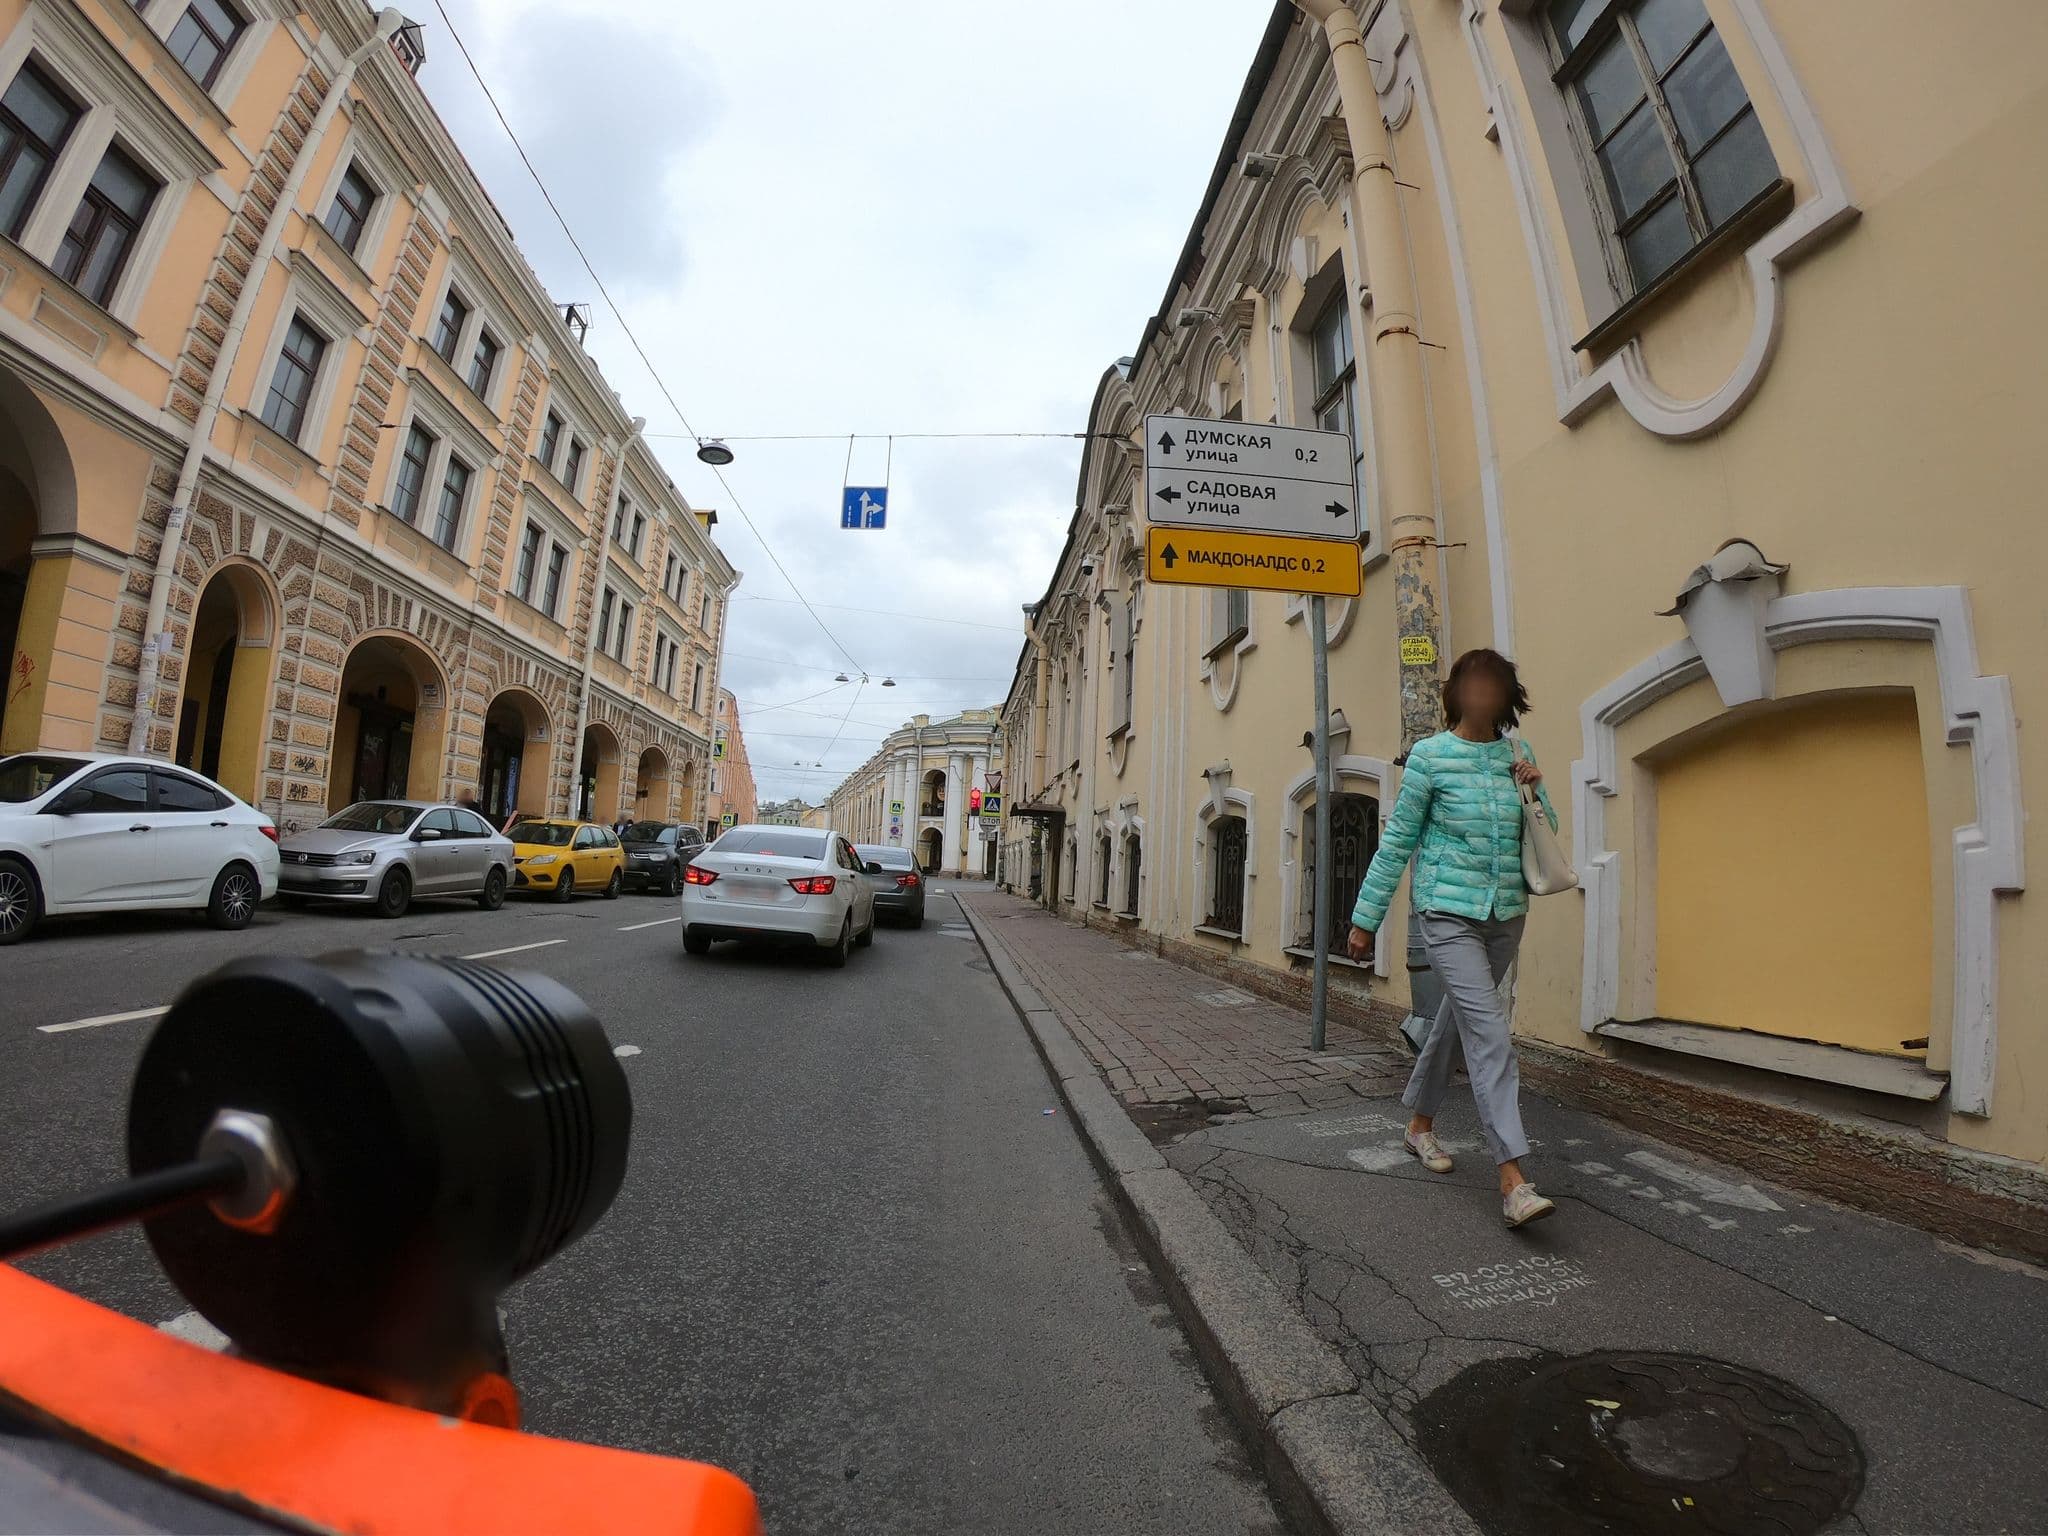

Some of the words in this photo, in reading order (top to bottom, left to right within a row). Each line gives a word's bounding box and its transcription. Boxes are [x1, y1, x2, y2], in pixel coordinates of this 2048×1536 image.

[1185, 429, 1272, 449] ДУМСКАЯ
[1186, 448, 1239, 463] улица
[1295, 448, 1319, 464] 0,2
[1187, 480, 1277, 500] САДОВАЯ
[1187, 501, 1240, 515] улица
[1188, 549, 1298, 571] МАКДОНАЛДС
[1301, 557, 1326, 574] 0,2
[734, 866, 773, 874] LADA
[1449, 1272, 1546, 1298] КРЫШАМ
